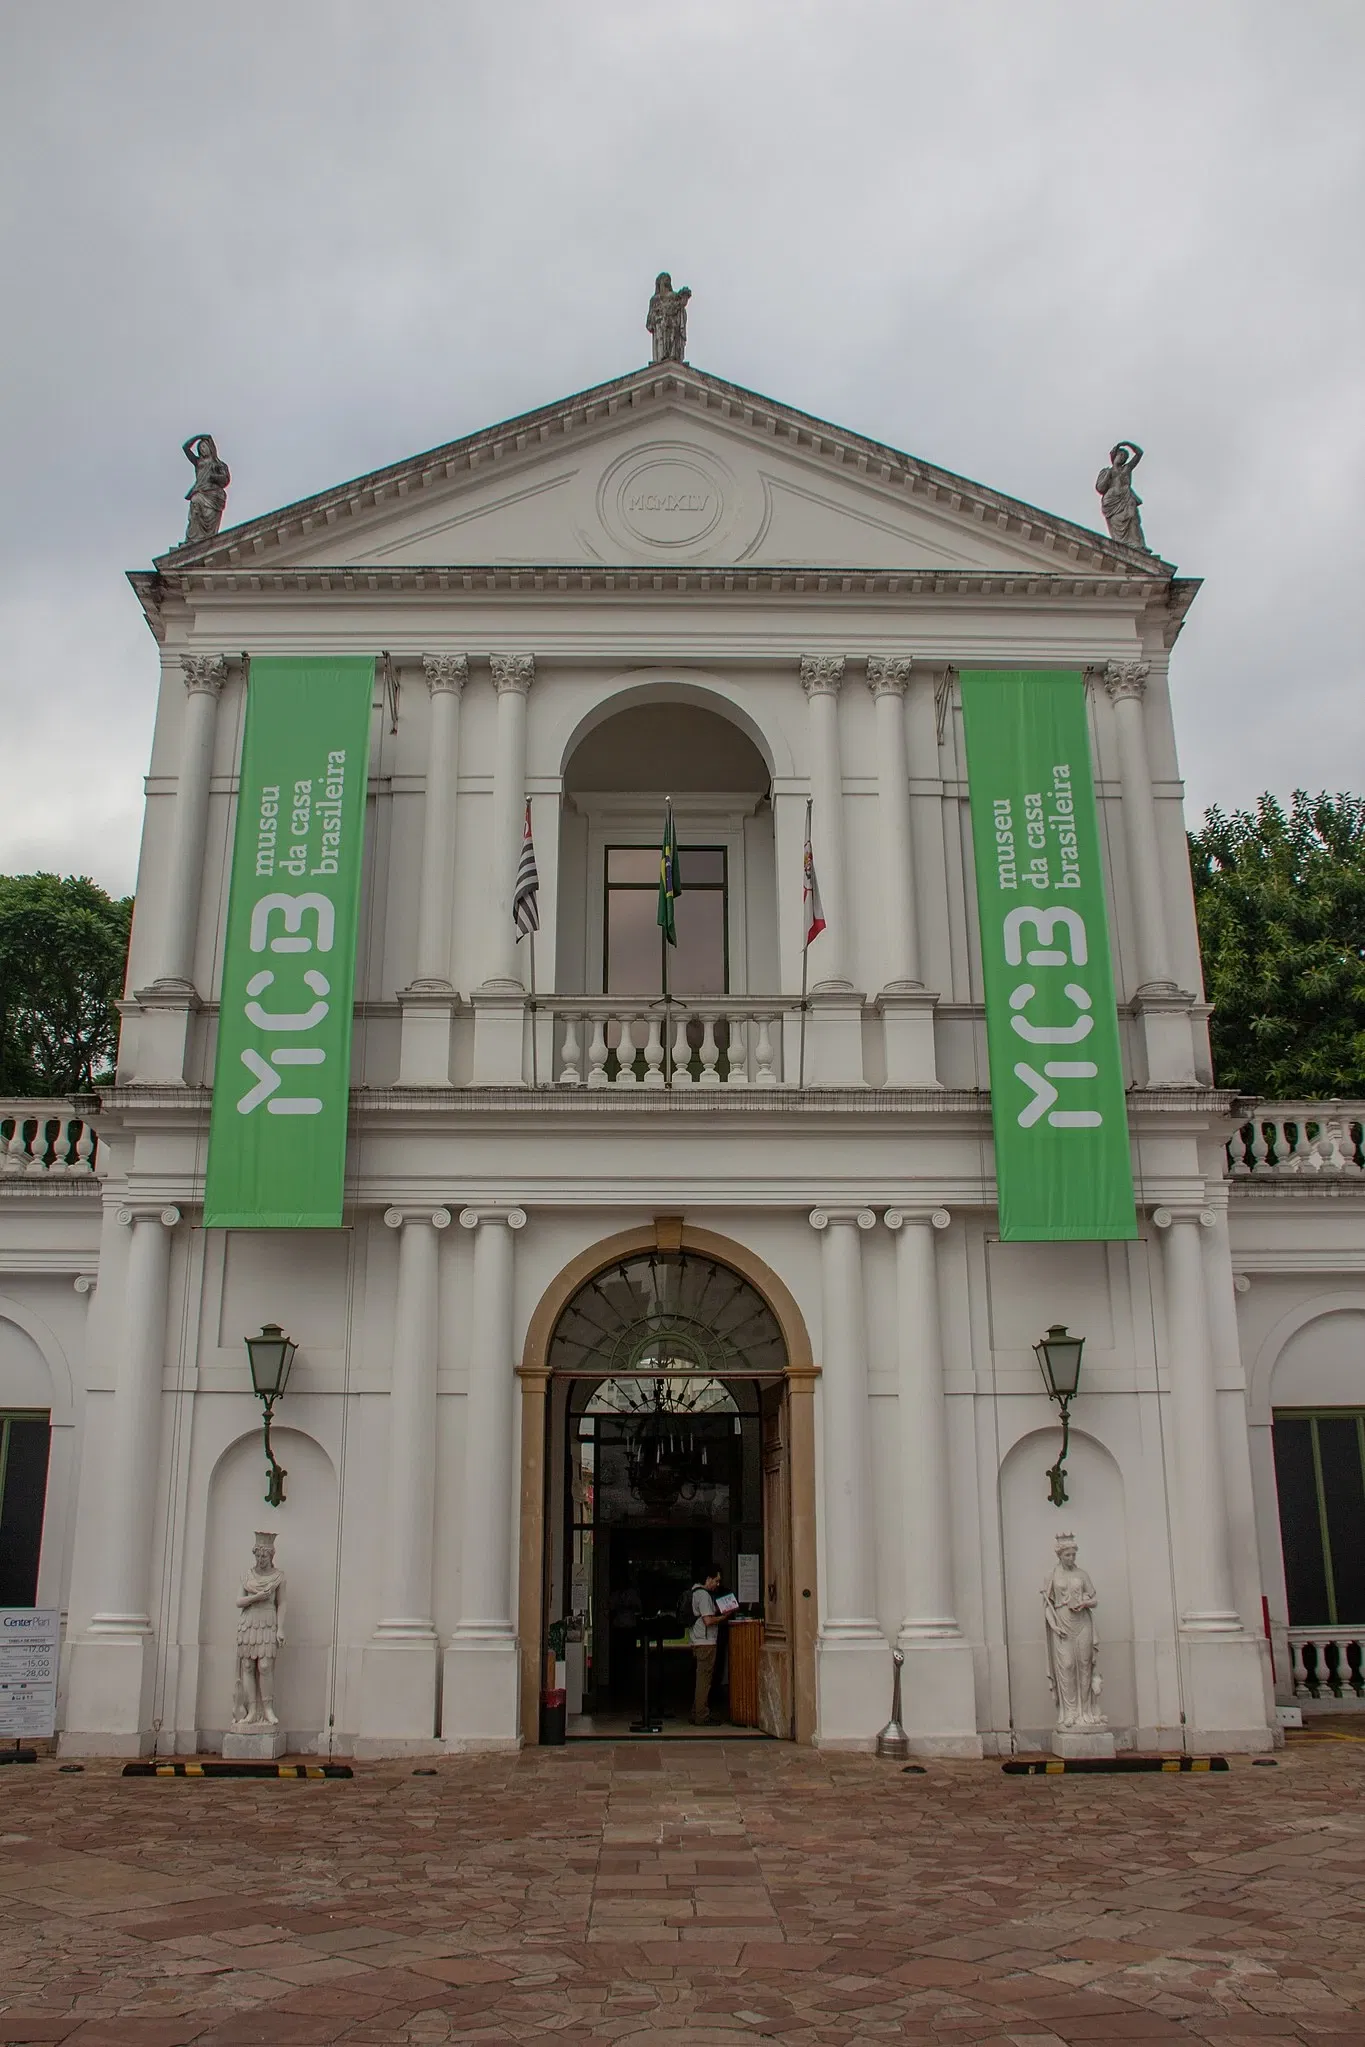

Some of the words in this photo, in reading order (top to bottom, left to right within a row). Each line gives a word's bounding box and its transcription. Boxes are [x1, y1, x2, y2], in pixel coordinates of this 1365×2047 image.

[629, 495, 710, 511] MCMXLV
[255, 785, 280, 876] museu
[291, 780, 312, 836] casa
[310, 750, 346, 876] brasileira
[993, 799, 1018, 889] museu
[1024, 793, 1046, 849] casa
[1047, 764, 1081, 889] brasileira
[279, 844, 308, 876] da
[1022, 857, 1050, 889] da
[236, 892, 336, 1115] MCB
[1003, 906, 1103, 1128] MCB
